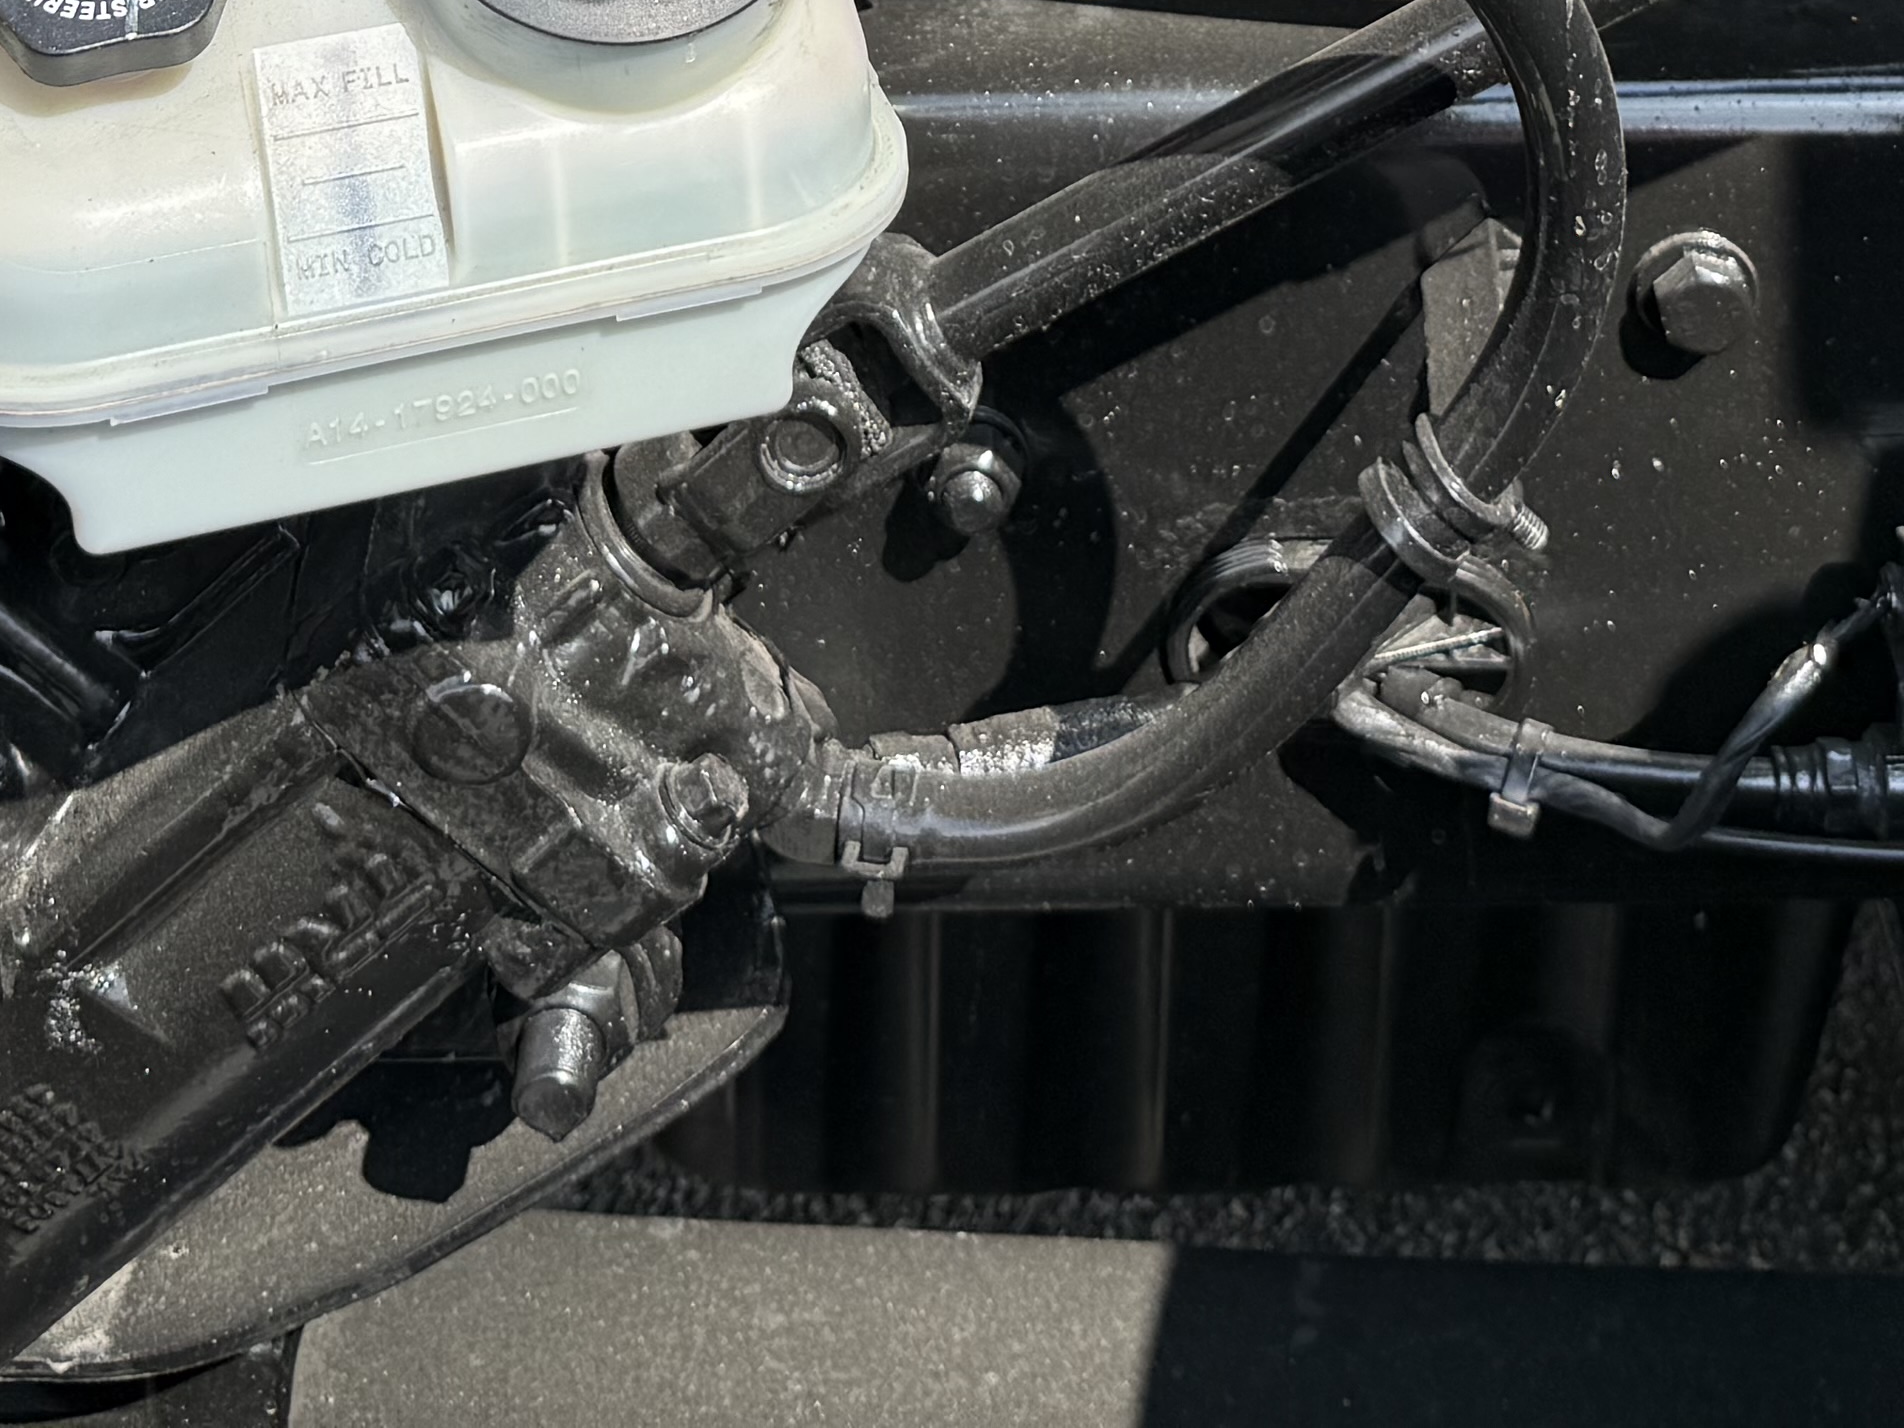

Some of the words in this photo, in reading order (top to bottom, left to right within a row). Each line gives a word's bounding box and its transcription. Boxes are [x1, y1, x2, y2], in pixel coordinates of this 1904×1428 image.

[267, 74, 330, 106] MAX
[340, 62, 410, 94] FILL
[296, 249, 351, 281] MIN
[367, 233, 437, 268] COLD
